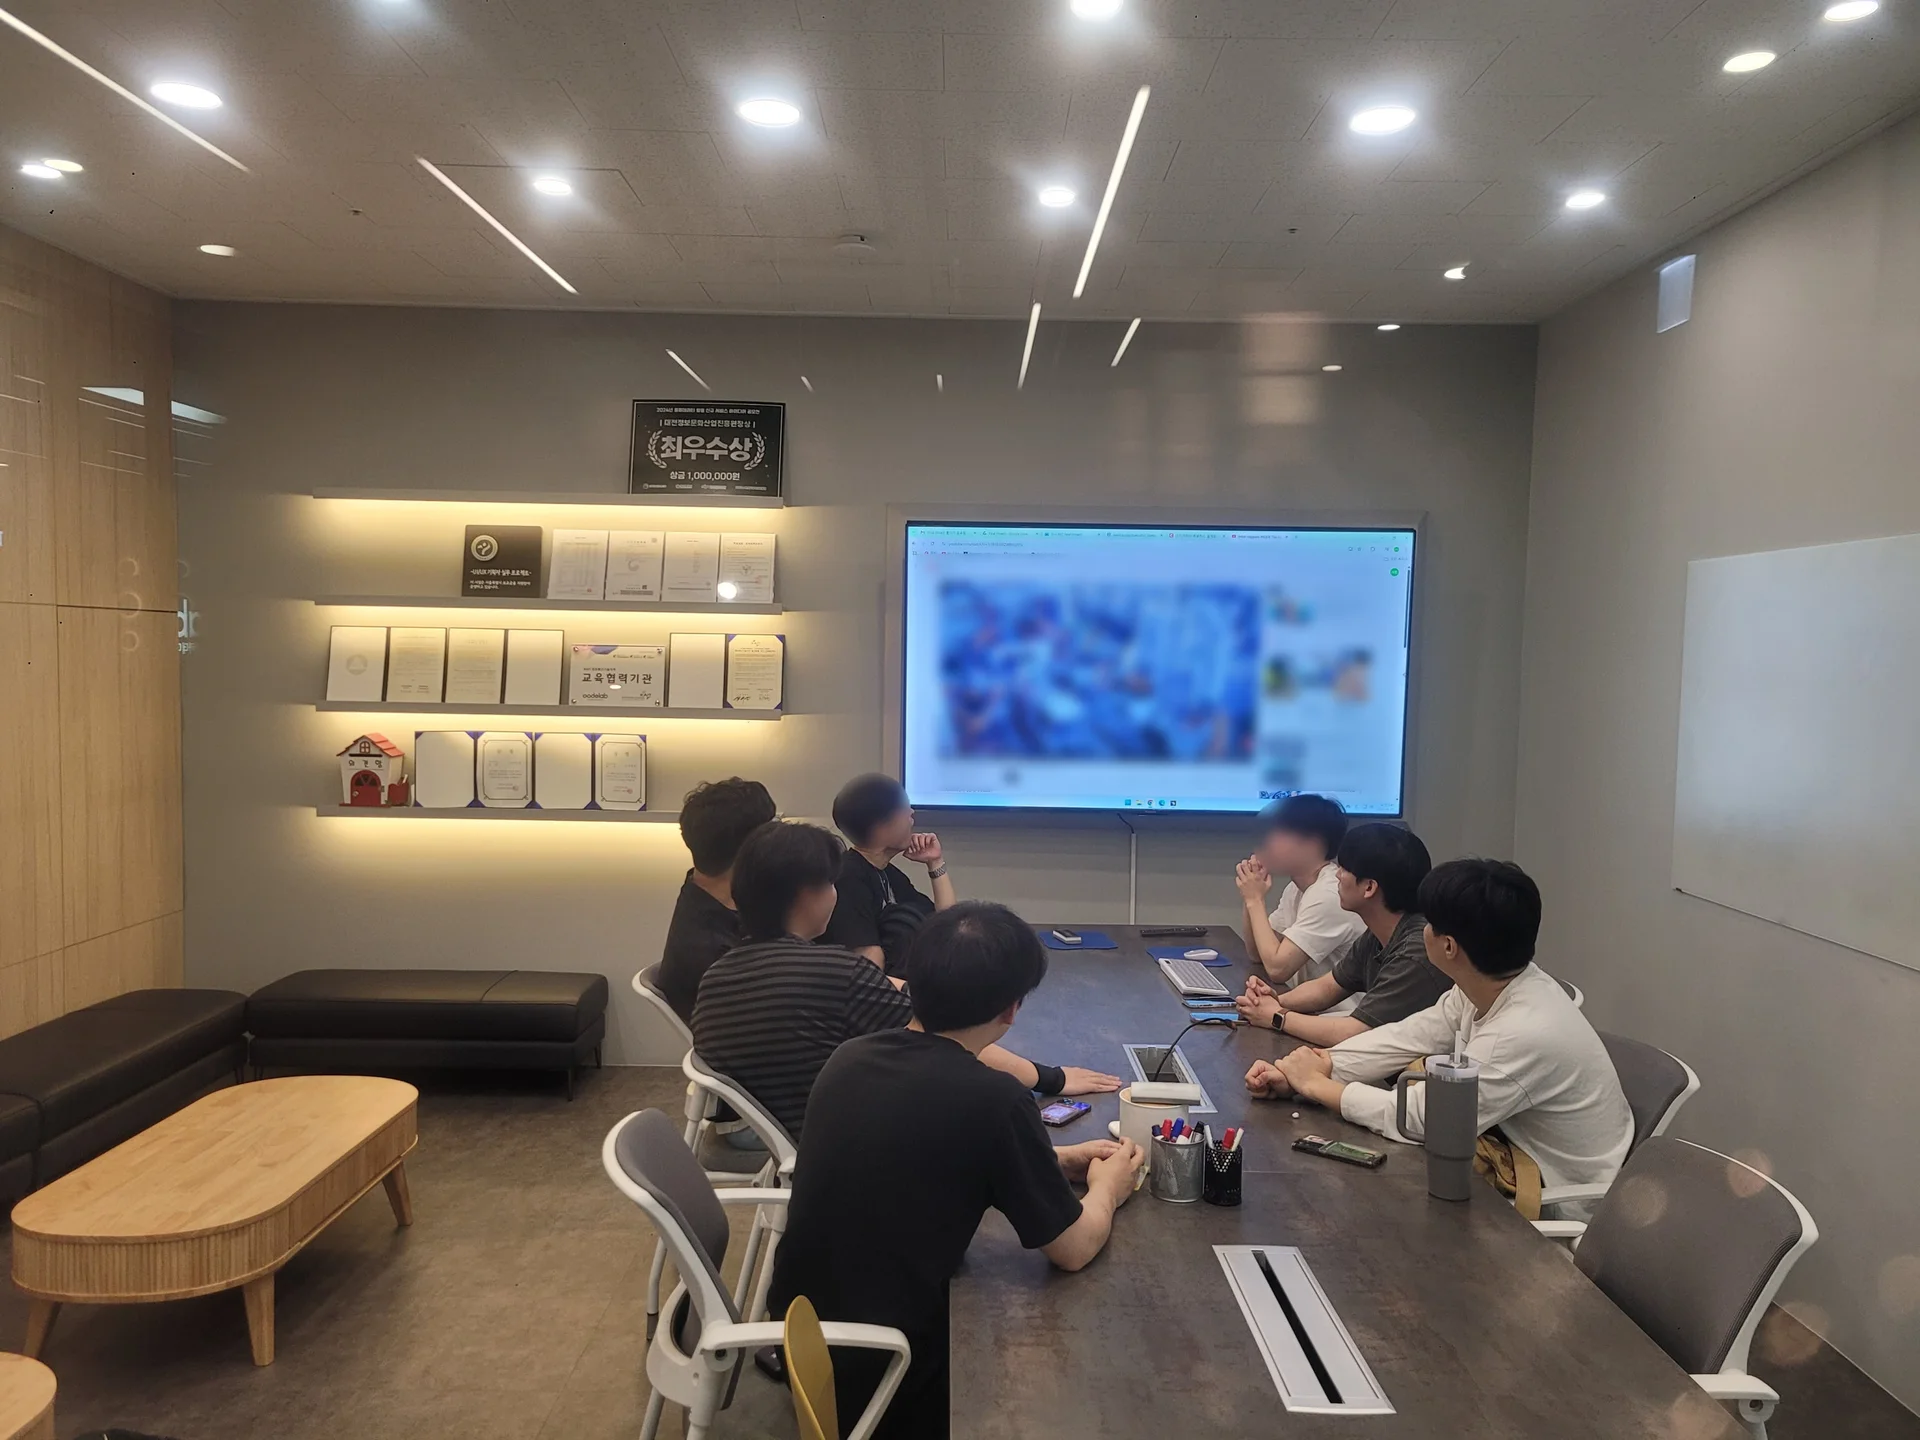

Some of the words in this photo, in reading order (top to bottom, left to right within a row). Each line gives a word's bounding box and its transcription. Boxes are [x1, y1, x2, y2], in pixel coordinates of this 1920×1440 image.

[660, 436, 753, 462] 최우수상
[670, 471, 686, 480] 상금
[687, 471, 740, 481] 1,000,000원
[582, 672, 652, 684] 교육협력기관
